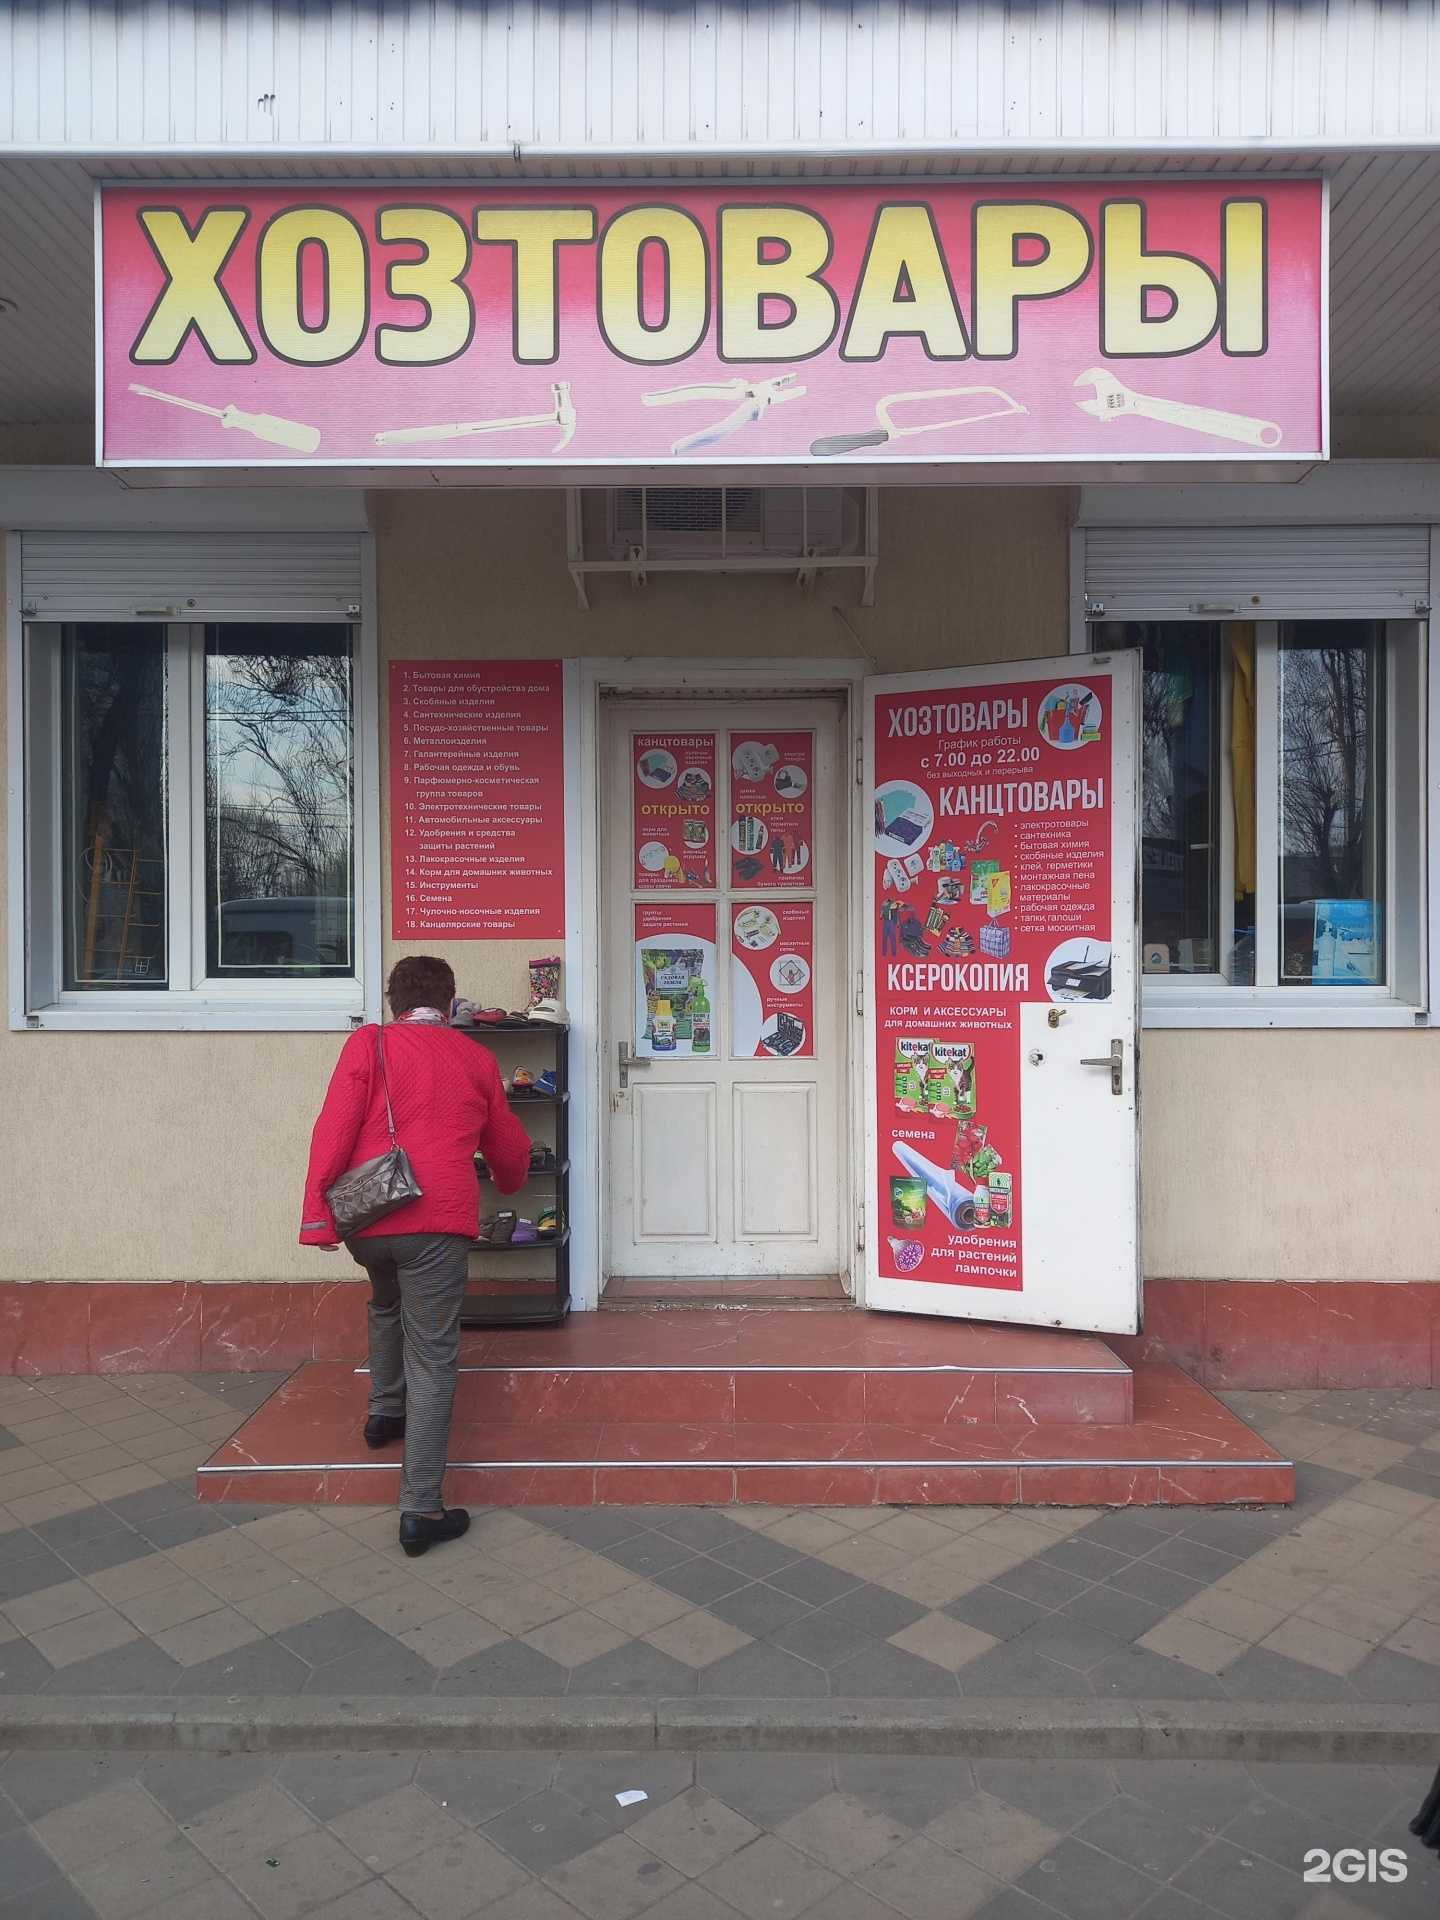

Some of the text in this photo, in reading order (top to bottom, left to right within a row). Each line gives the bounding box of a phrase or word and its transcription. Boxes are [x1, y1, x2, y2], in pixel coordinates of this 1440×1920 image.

[130, 198, 1268, 366] ХОЗТОВАРЫ
[413, 672, 450, 680] Бытовая
[453, 672, 480, 680] химия
[414, 684, 445, 694] Товары
[448, 684, 464, 694] для
[467, 684, 525, 694] обустройства
[528, 684, 549, 694] дома
[459, 698, 495, 706] изделия
[413, 711, 482, 719] Сантехнические
[485, 711, 521, 719] изделия
[888, 697, 1028, 738] ХОЗТОВАРЫ
[517, 724, 548, 733] товары
[414, 737, 487, 745] Металлоизделия
[638, 738, 713, 748] канцтовары
[939, 736, 1021, 751] График работы
[414, 750, 480, 759] Галантерейные
[483, 750, 519, 759] изделия
[921, 747, 1040, 768] с 7.00 до 22.00
[414, 763, 450, 772] Рабочая
[452, 763, 484, 772] одежда
[487, 763, 491, 772] и
[494, 763, 519, 772] обувь
[943, 769, 982, 778] выходных
[992, 766, 1033, 776] перерыва
[414, 776, 539, 785] Парфюмерно-косметическая
[417, 790, 483, 798] группа товаров
[939, 778, 1104, 817] КАНЦТОВАРЫ
[405, 803, 542, 811] 10. Электротехнические товары
[641, 804, 709, 817] открыто
[736, 803, 804, 816] открыто
[405, 816, 542, 824] 11. Автомобильные аксессуары
[1020, 819, 1088, 830] электротовары
[405, 829, 515, 837] 12. Удобрения и средства
[1020, 831, 1071, 839] сантехника
[419, 842, 495, 850] защиты растений
[1020, 840, 1089, 850] бытовая химия
[405, 855, 525, 863] 13. Лакокрасочные изделия
[1020, 851, 1104, 860] скобяные изделия
[1046, 861, 1093, 871] герметики
[405, 868, 552, 877] 14. Корм для домашних животных
[1020, 872, 1070, 881] монтажная
[406, 881, 478, 890] 15. Инструменты
[1020, 883, 1090, 891] лакокрасочные
[406, 894, 452, 902] 16. Семена
[1020, 893, 1071, 902] материалы
[406, 907, 540, 916] 17. Чулочно-носочные изделия
[1020, 903, 1095, 912] рабочая одежда
[406, 920, 515, 929] 18. Канцелярские товары
[1020, 923, 1096, 932] сетка москитная
[888, 963, 1029, 992] КСЕРОКОПИЯ
[890, 1007, 1006, 1017] КОРМ И АКСЕССУАРЫ
[885, 1020, 1012, 1029] для домашних животных
[901, 1042, 928, 1052] kiteka
[935, 1047, 966, 1057] kitekat
[891, 1129, 935, 1139] семена
[948, 1234, 1017, 1248] удобрения
[931, 1248, 1017, 1263] для растений
[955, 1264, 1017, 1277] лампочки
